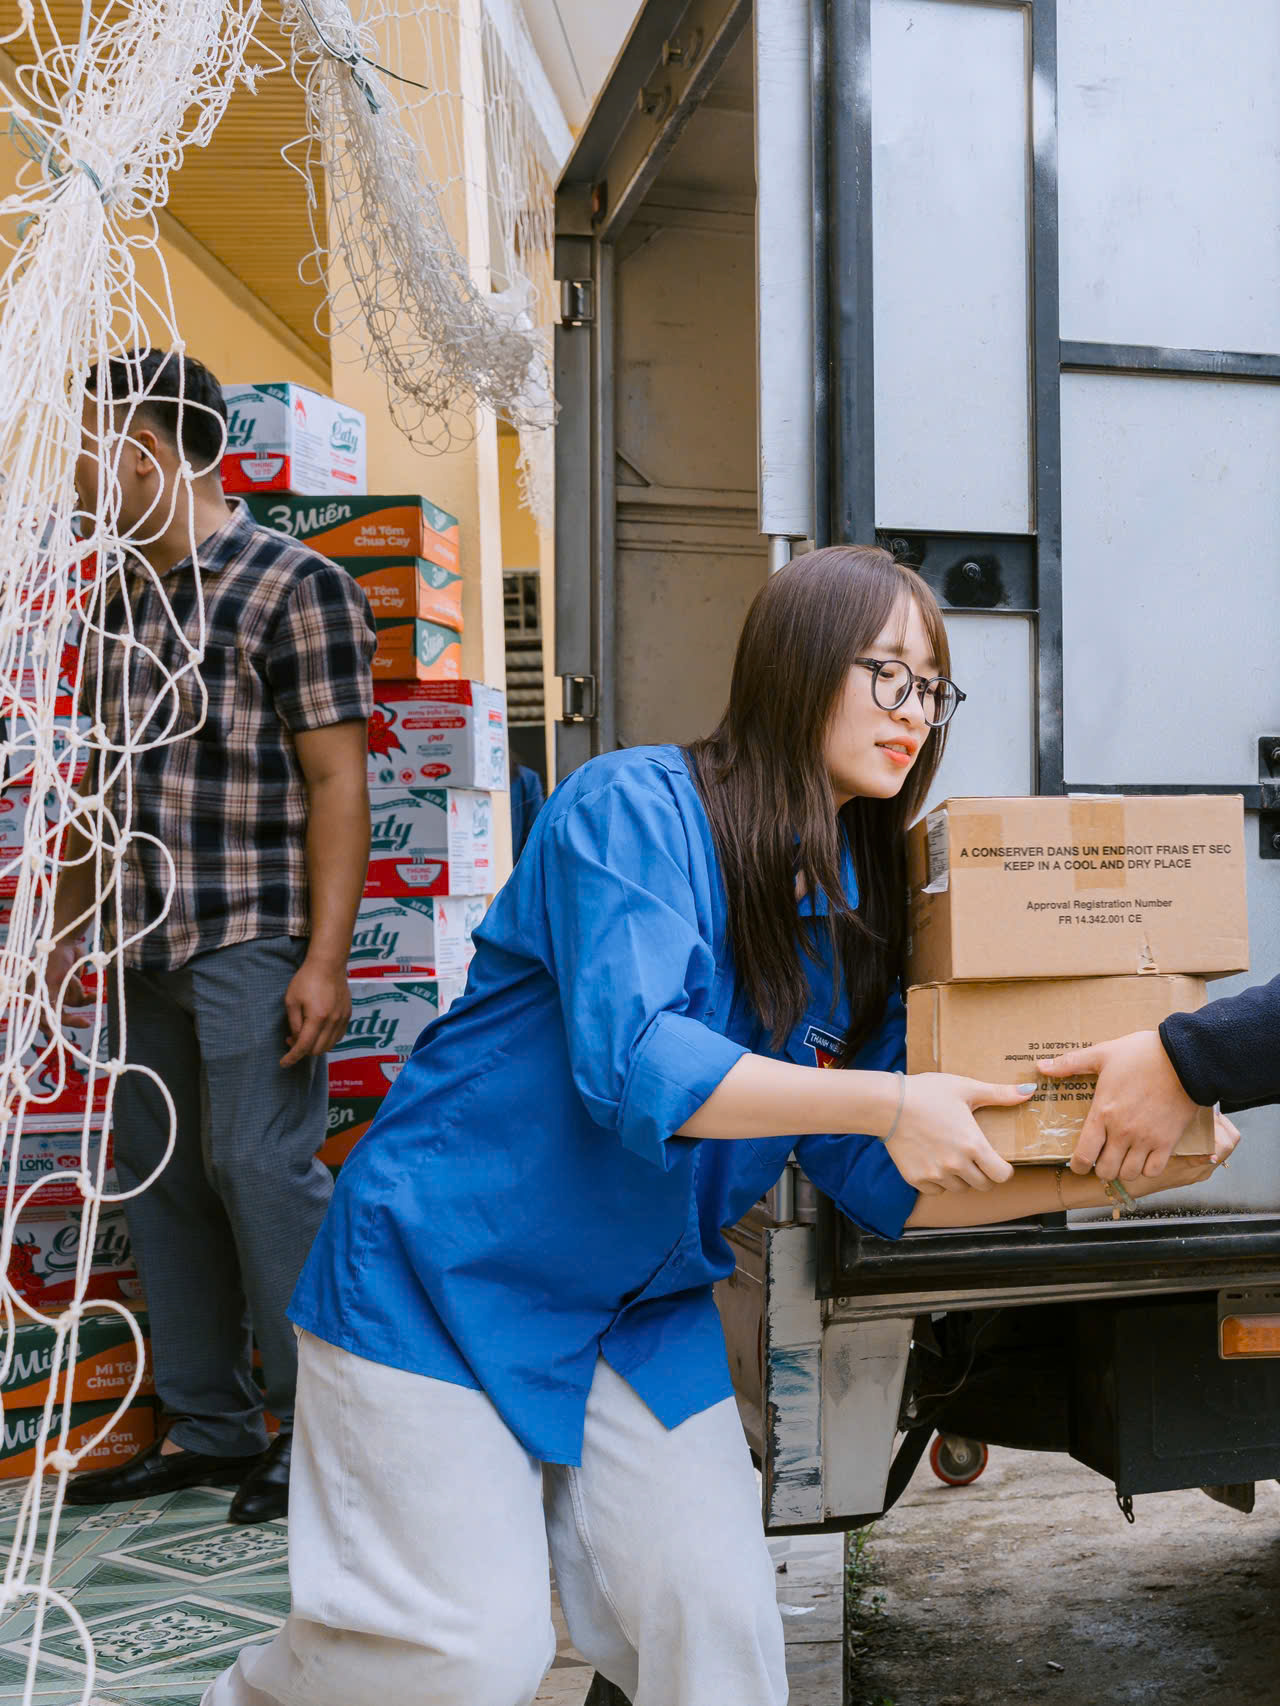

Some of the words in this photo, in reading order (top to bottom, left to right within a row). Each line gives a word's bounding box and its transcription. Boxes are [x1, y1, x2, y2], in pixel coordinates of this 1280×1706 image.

[227, 410, 256, 447] ty
[379, 525, 405, 535] Tôm
[354, 536, 385, 546] Chua
[387, 536, 410, 548] Cay
[382, 597, 405, 608] Cay
[371, 814, 414, 851] aty
[960, 848, 969, 858] A
[971, 847, 1044, 858] CONSERVER
[1047, 846, 1079, 857] DANS
[1082, 846, 1099, 857] UN
[1102, 845, 1153, 856] ENDROIT
[1156, 845, 1189, 855] FRAIS
[1192, 844, 1206, 855] ET
[1208, 844, 1232, 854] SEC
[1004, 861, 1035, 871] KEEP
[1038, 861, 1050, 871] IN
[1053, 860, 1061, 871] A
[1064, 860, 1097, 870] COOL
[1099, 860, 1125, 870] AND
[1128, 859, 1151, 870] DRY
[1154, 859, 1191, 869] PLACE
[1027, 900, 1070, 912] Approval
[1073, 899, 1132, 911] Registration
[1135, 898, 1173, 908] Number
[1058, 915, 1072, 925] FR
[1075, 914, 1125, 925] 14.342.001
[1128, 914, 1142, 924] CE
[352, 922, 400, 959] aty
[346, 1009, 400, 1048] aty
[1028, 1042, 1039, 1050] CE
[1042, 1042, 1080, 1050] 14.342.001
[1064, 1082, 1088, 1090] COOL
[1060, 1093, 1073, 1101] UN
[1075, 1093, 1094, 1101] ANS
[87, 1377, 125, 1388] Chua
[113, 1443, 140, 1454] Cay
